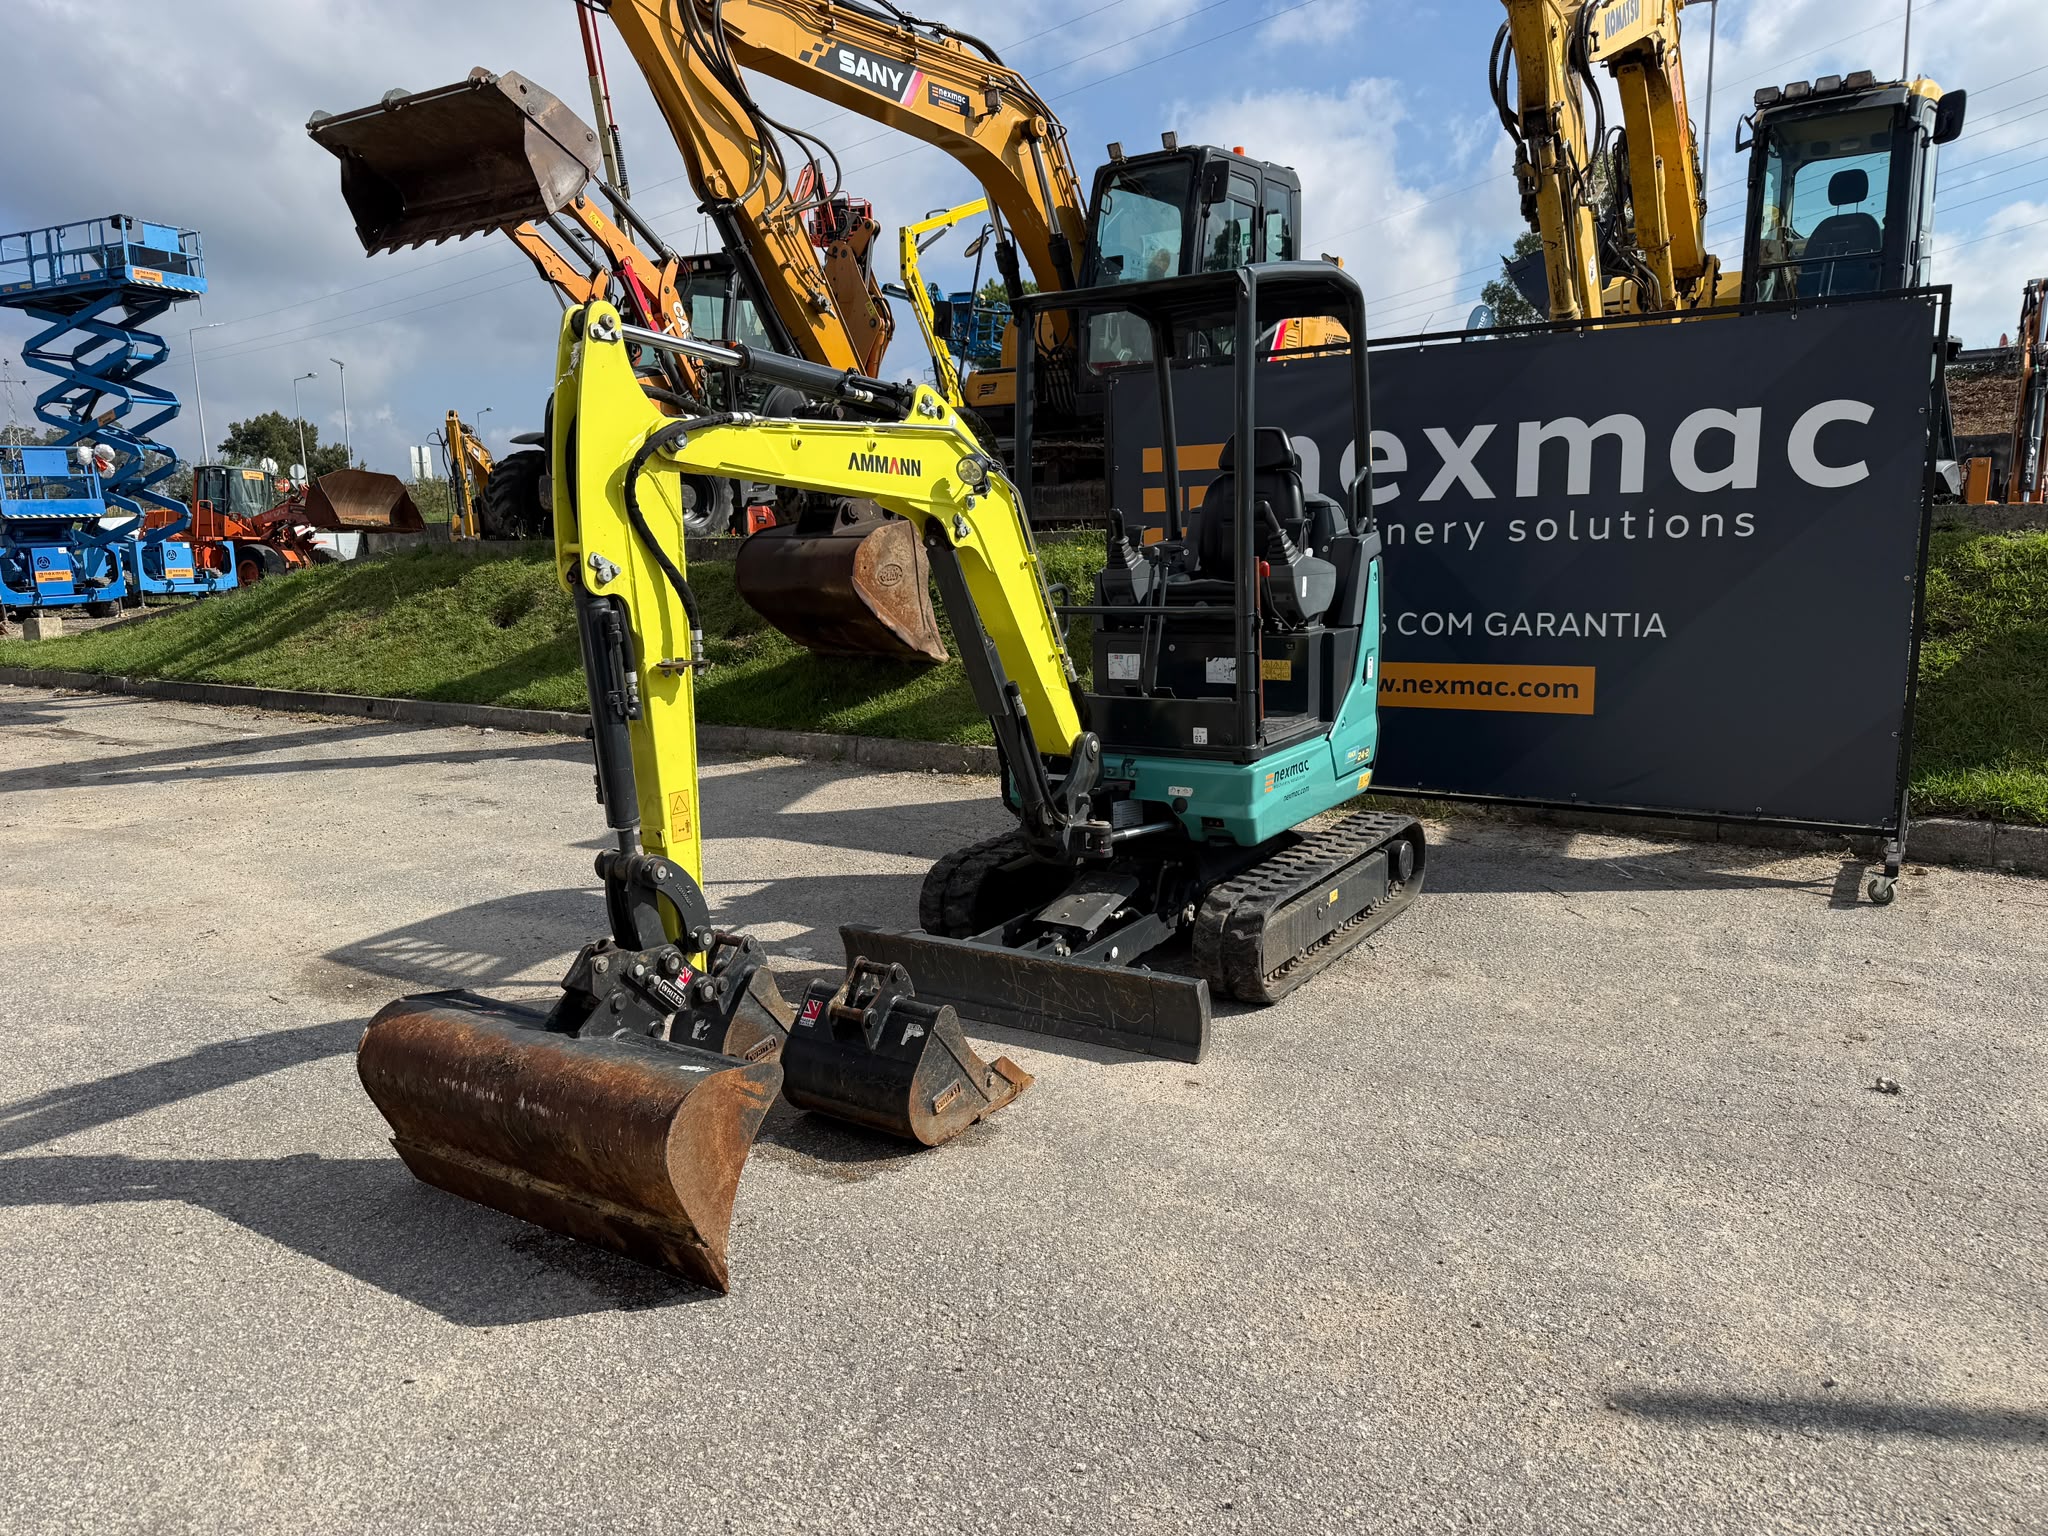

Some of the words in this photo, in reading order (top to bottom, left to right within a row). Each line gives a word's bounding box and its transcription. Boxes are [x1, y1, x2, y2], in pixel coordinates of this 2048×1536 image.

[1605, 0, 1640, 40] KOMATSU
[838, 49, 904, 92] SANY
[938, 88, 966, 104] nexmac
[673, 301, 693, 340] CA
[848, 452, 921, 477] AMMANN
[1508, 508, 1756, 543] solutions
[1397, 611, 1473, 636] COM
[1484, 611, 1668, 639] GARANTIA
[1274, 759, 1309, 783] nexmac
[661, 983, 683, 1004] WHITES
